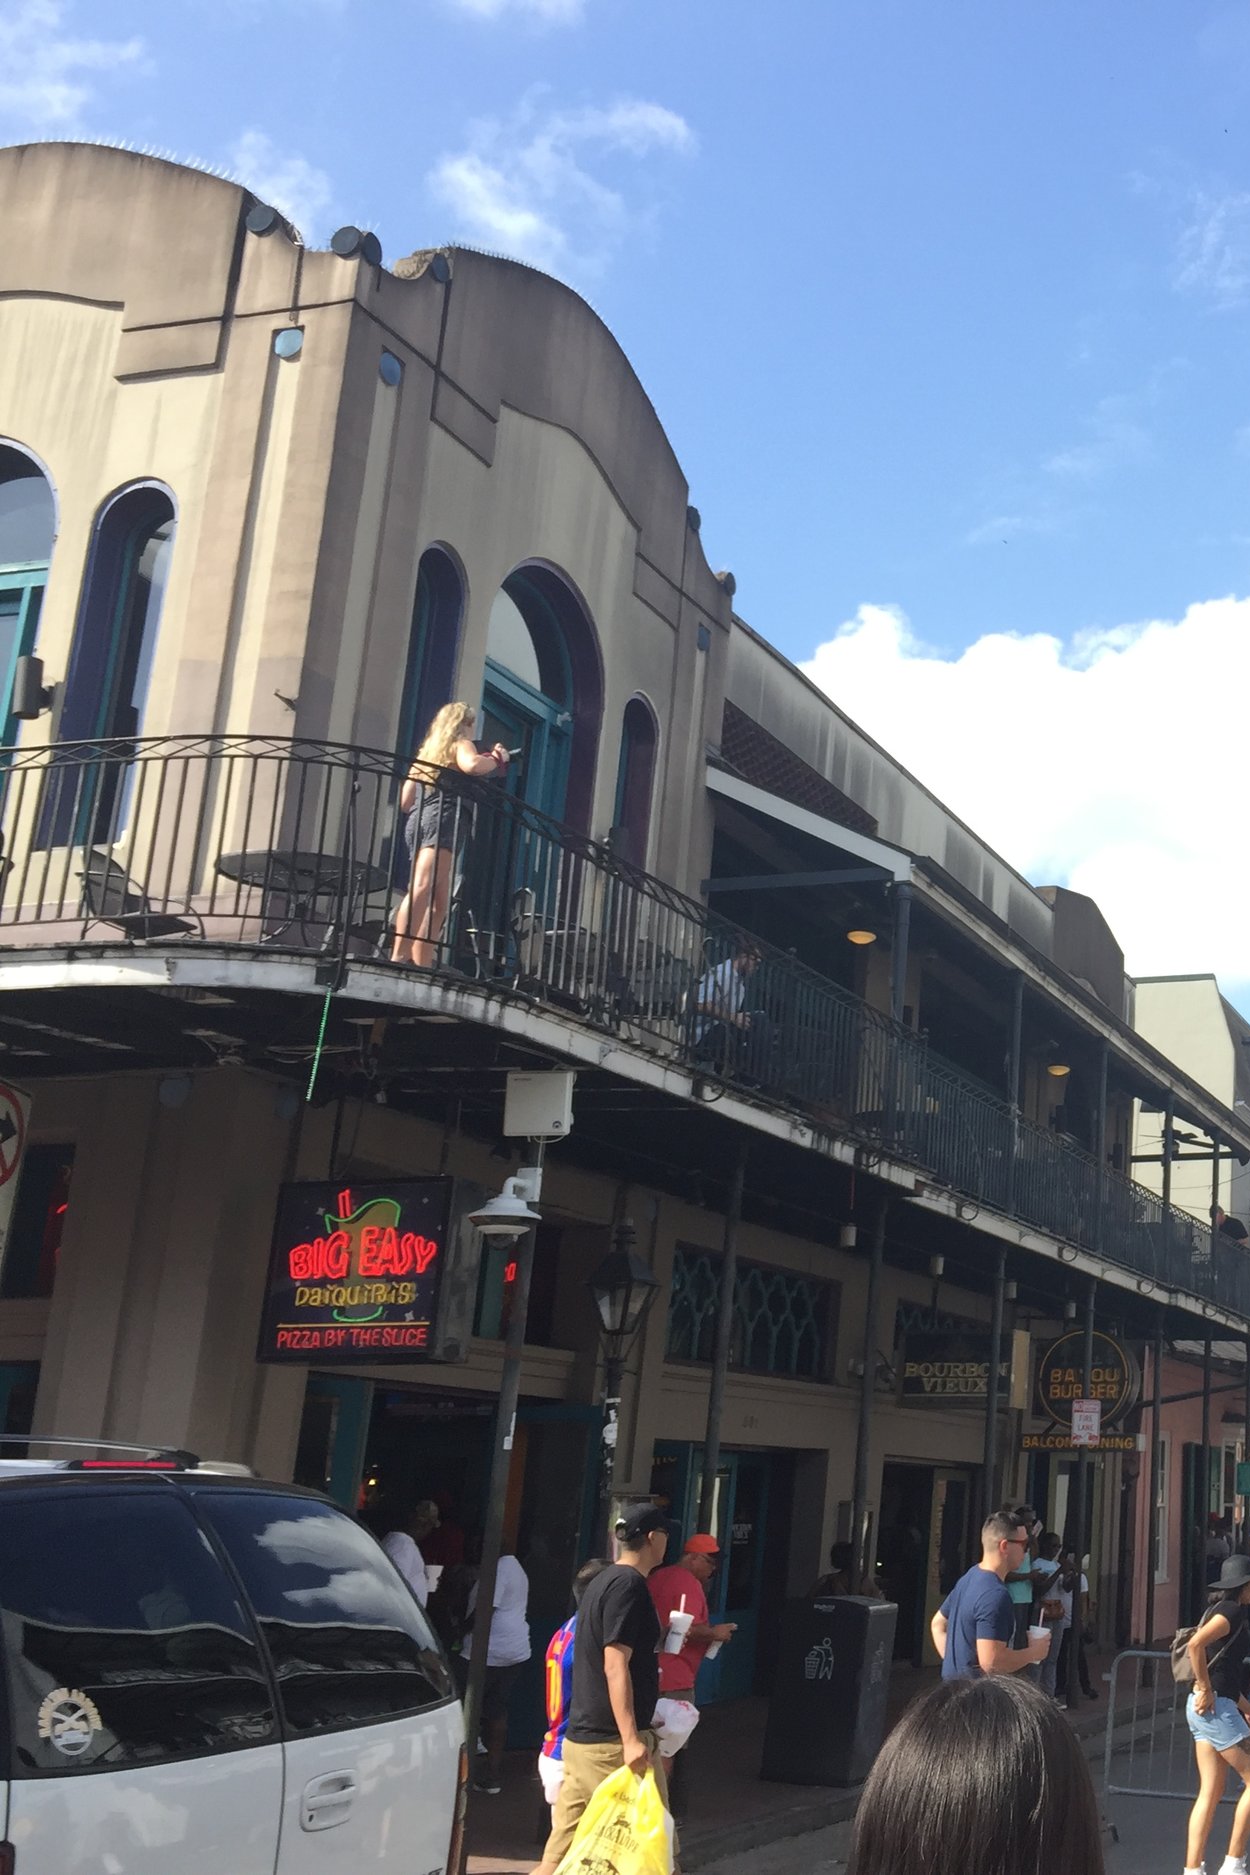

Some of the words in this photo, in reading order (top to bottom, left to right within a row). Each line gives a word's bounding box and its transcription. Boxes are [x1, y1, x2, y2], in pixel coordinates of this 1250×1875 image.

[289, 1231, 350, 1279] BIG
[358, 1225, 437, 1276] EASY
[277, 1331, 321, 1348] PIZZA
[324, 1330, 346, 1346] BY
[350, 1328, 383, 1347] THE
[383, 1328, 428, 1346] SLICE
[1050, 1368, 1120, 1382] BAOU
[922, 1377, 988, 1392] VIEUX
